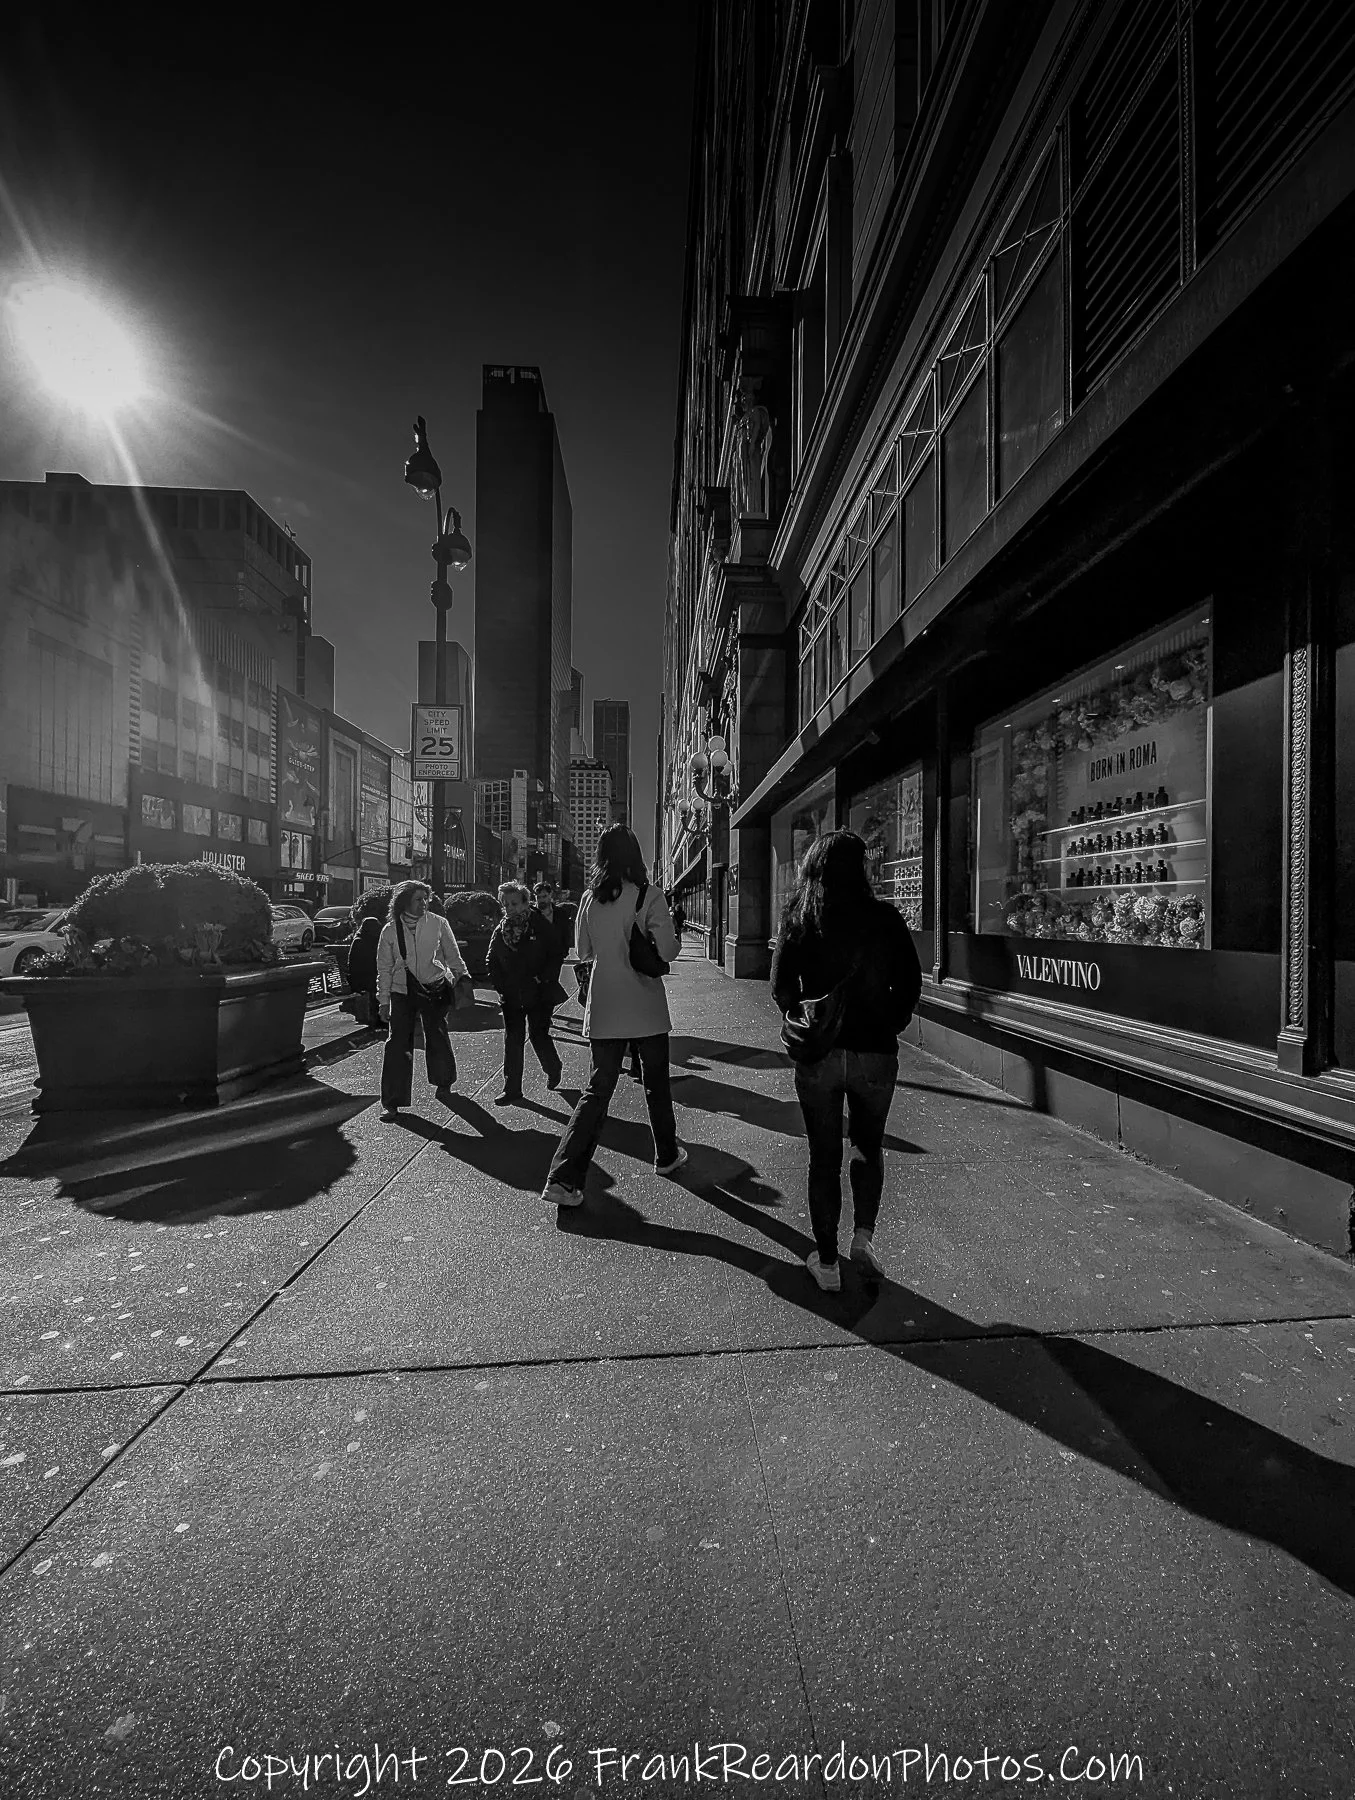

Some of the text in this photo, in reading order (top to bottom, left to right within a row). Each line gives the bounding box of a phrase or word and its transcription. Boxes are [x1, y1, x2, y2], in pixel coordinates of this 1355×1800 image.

[420, 736, 454, 756] 25
[1090, 741, 1157, 782] BORN IN ROMA
[202, 850, 246, 872] HOLLISTER
[295, 872, 330, 883] SKECERS
[1016, 954, 1101, 991] VALENTINO
